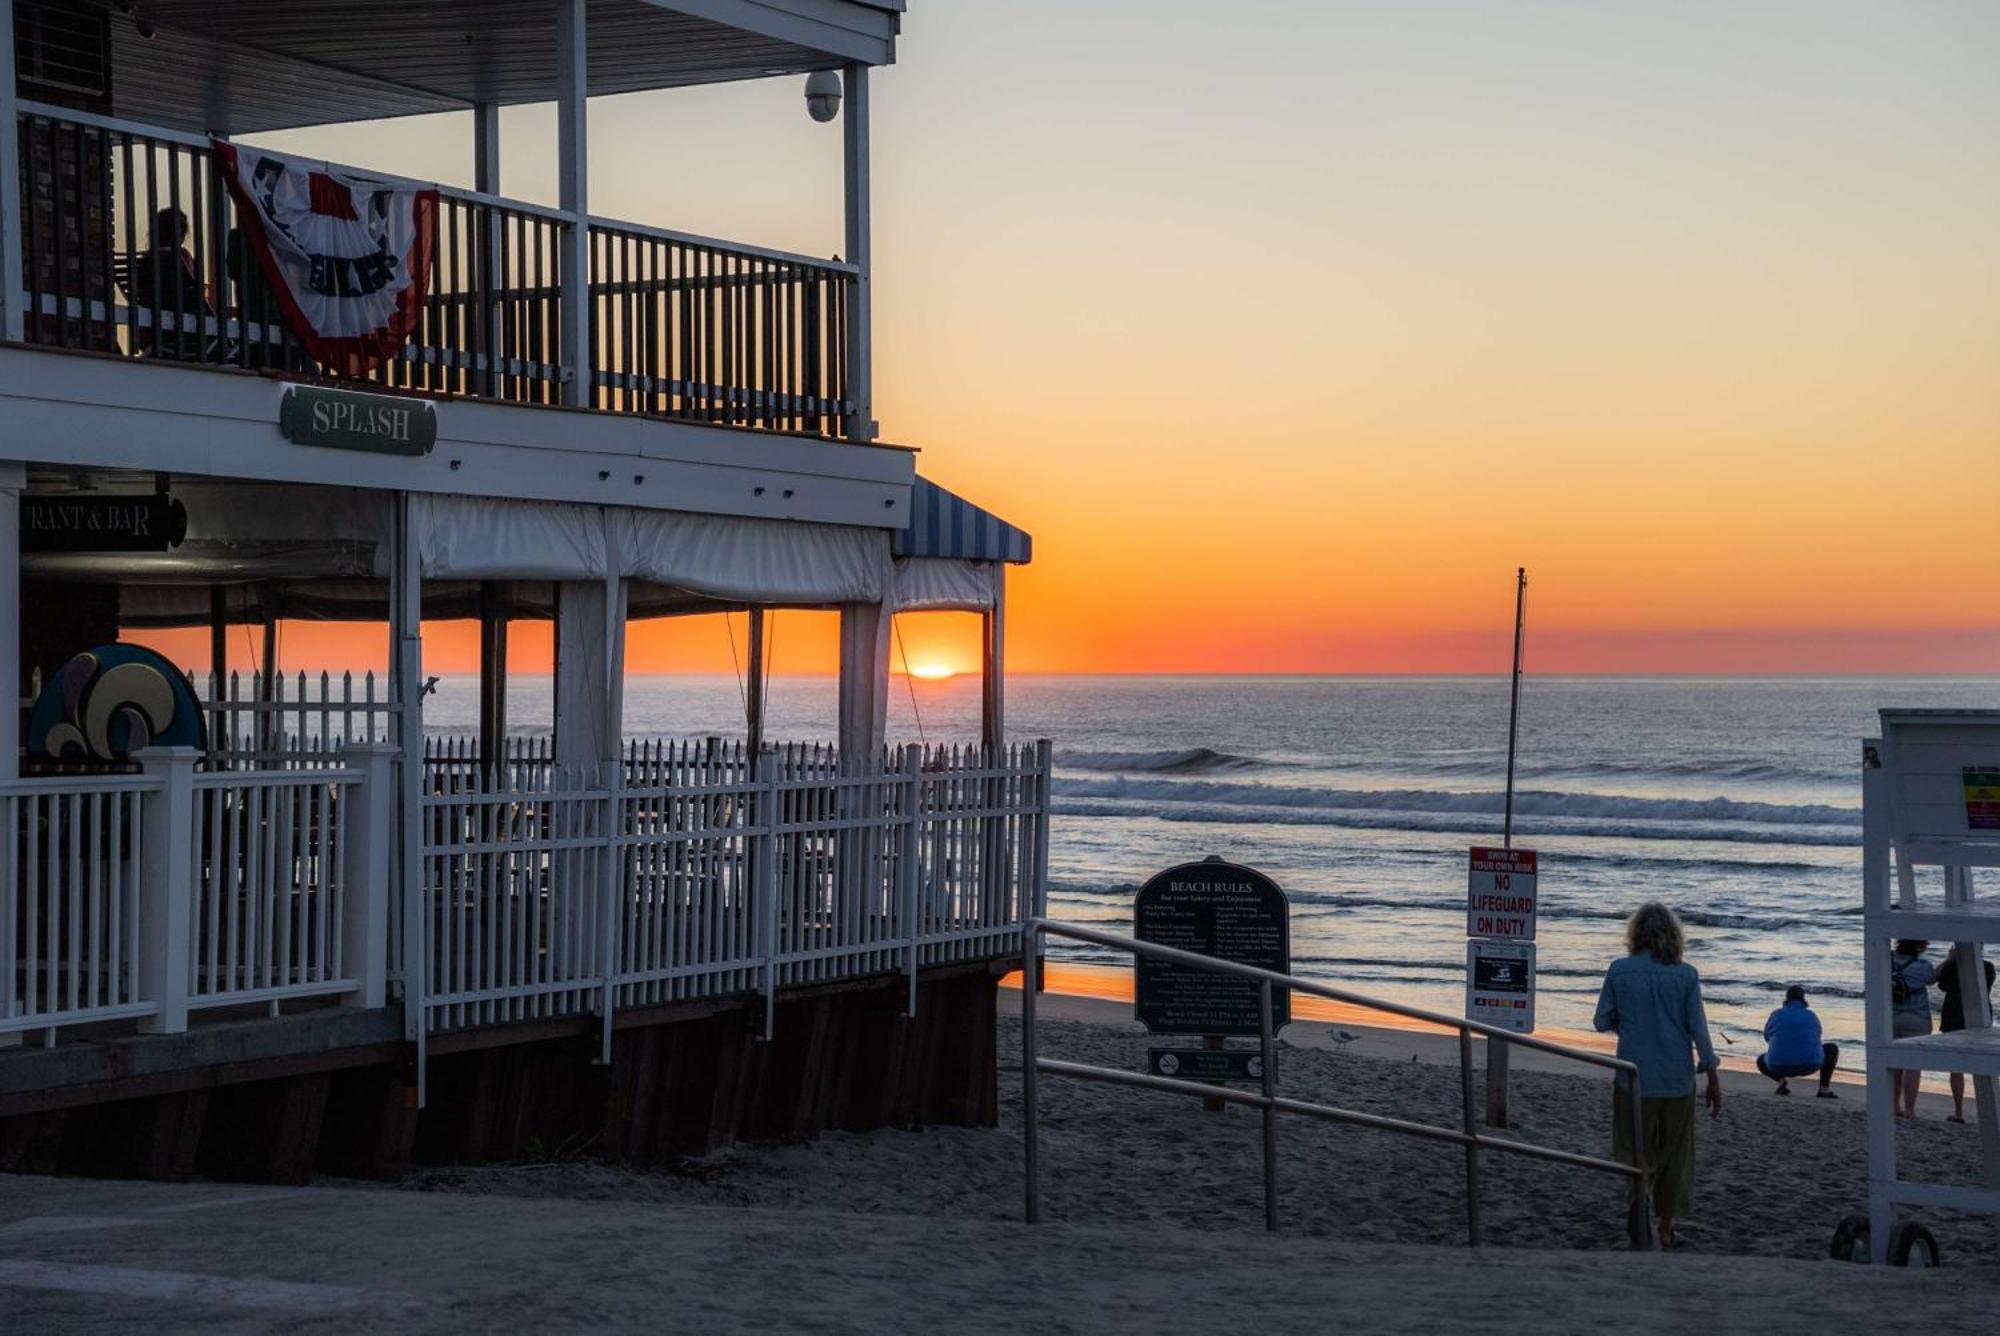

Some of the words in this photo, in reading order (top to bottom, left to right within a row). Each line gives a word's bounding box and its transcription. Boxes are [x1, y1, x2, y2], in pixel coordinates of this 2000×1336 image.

[312, 400, 411, 440] SPLASH
[27, 504, 83, 530] RANT
[87, 504, 101, 530] &
[108, 504, 150, 536] BAR
[1170, 882, 1211, 892] BEACH
[1214, 882, 1252, 893] RULES
[1495, 874, 1510, 890] NO
[1472, 895, 1532, 913] LIFEGUARD
[1477, 917, 1492, 933] ON
[1497, 918, 1525, 935] DUTY
